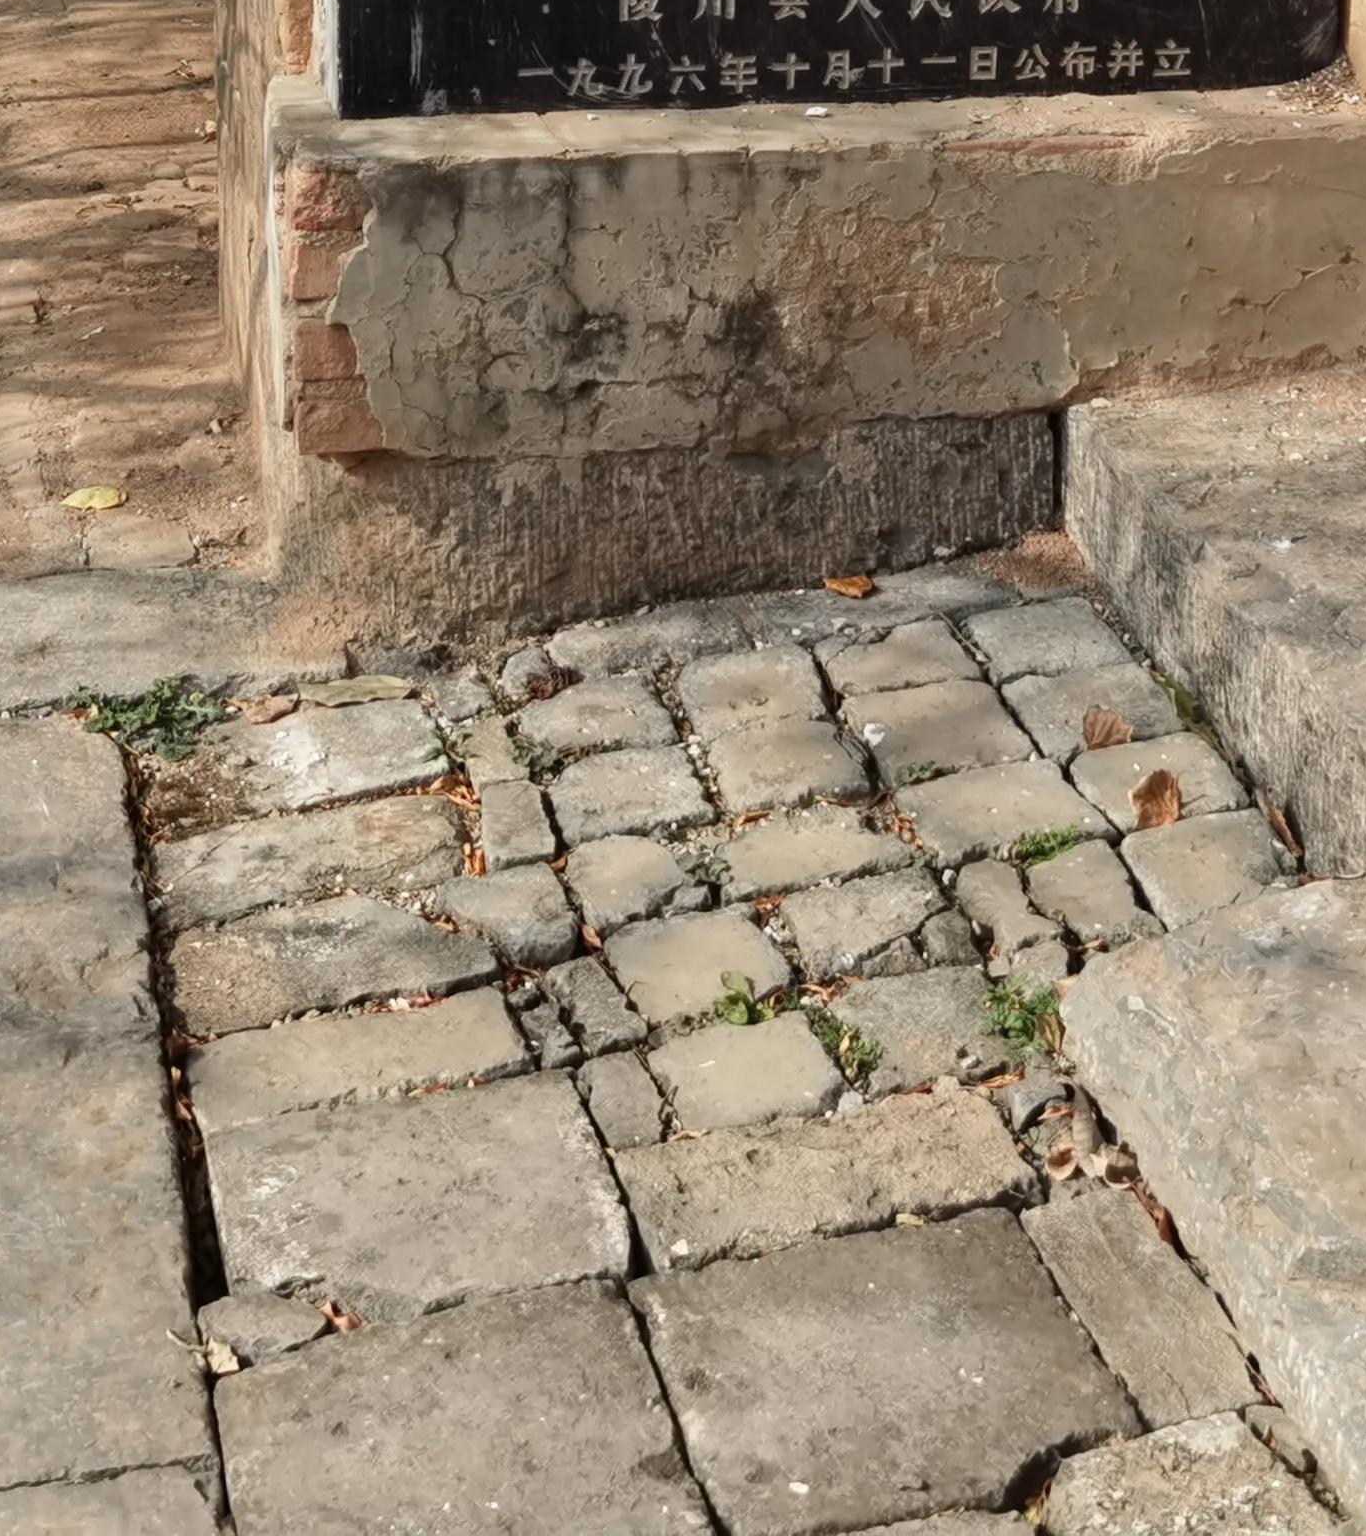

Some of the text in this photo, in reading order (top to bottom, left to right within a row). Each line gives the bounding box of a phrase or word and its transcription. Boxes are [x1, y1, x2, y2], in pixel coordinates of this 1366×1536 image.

[516, 38, 1195, 99] 一九九六年十月十一日公布并立
